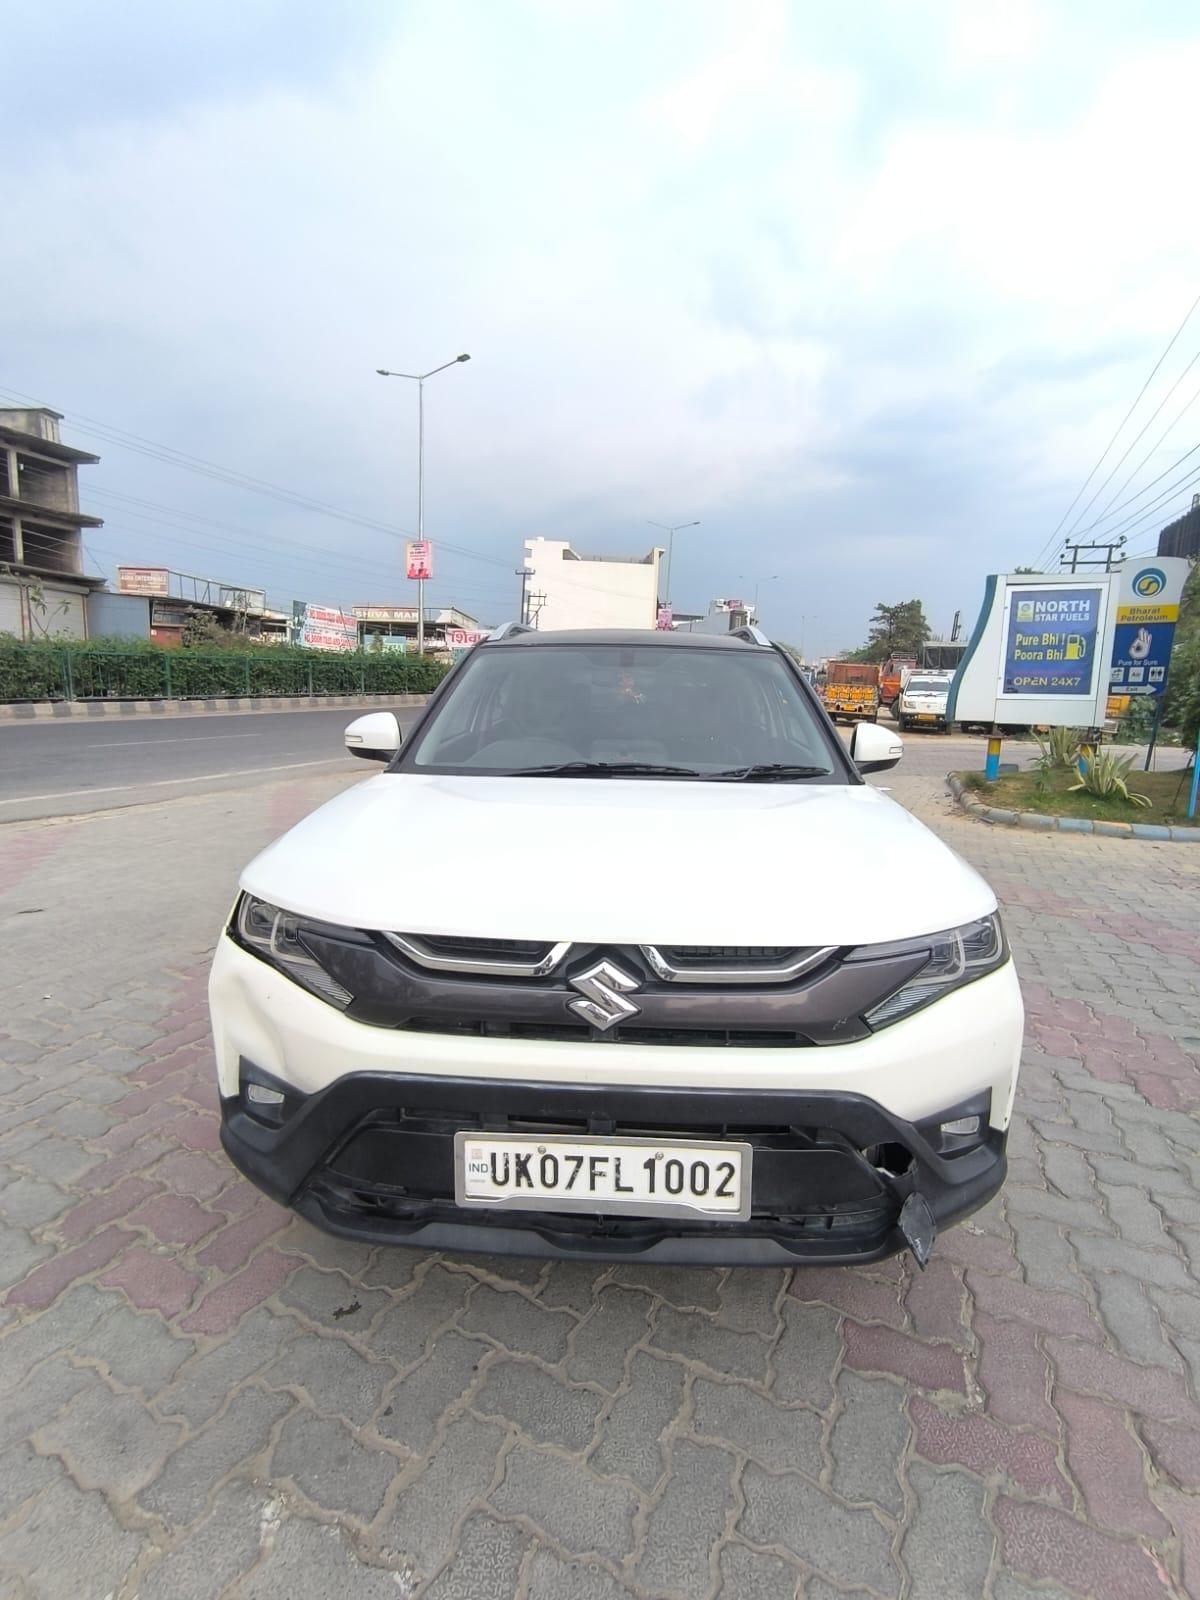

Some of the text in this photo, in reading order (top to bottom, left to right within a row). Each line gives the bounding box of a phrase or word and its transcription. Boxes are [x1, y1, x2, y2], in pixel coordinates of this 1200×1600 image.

[1035, 600, 1090, 612] NORTH
[1129, 607, 1161, 615] Bharat
[355, 610, 390, 619] SHIVA
[1034, 612, 1090, 622] STAR FUELS
[1016, 633, 1040, 646] Pure
[1042, 633, 1059, 646] Bhi
[1014, 649, 1063, 660] Poora Bhi
[1013, 677, 1048, 686] OPEN
[468, 1162, 489, 1174] IND
[490, 1151, 736, 1198] UK07FL1002
